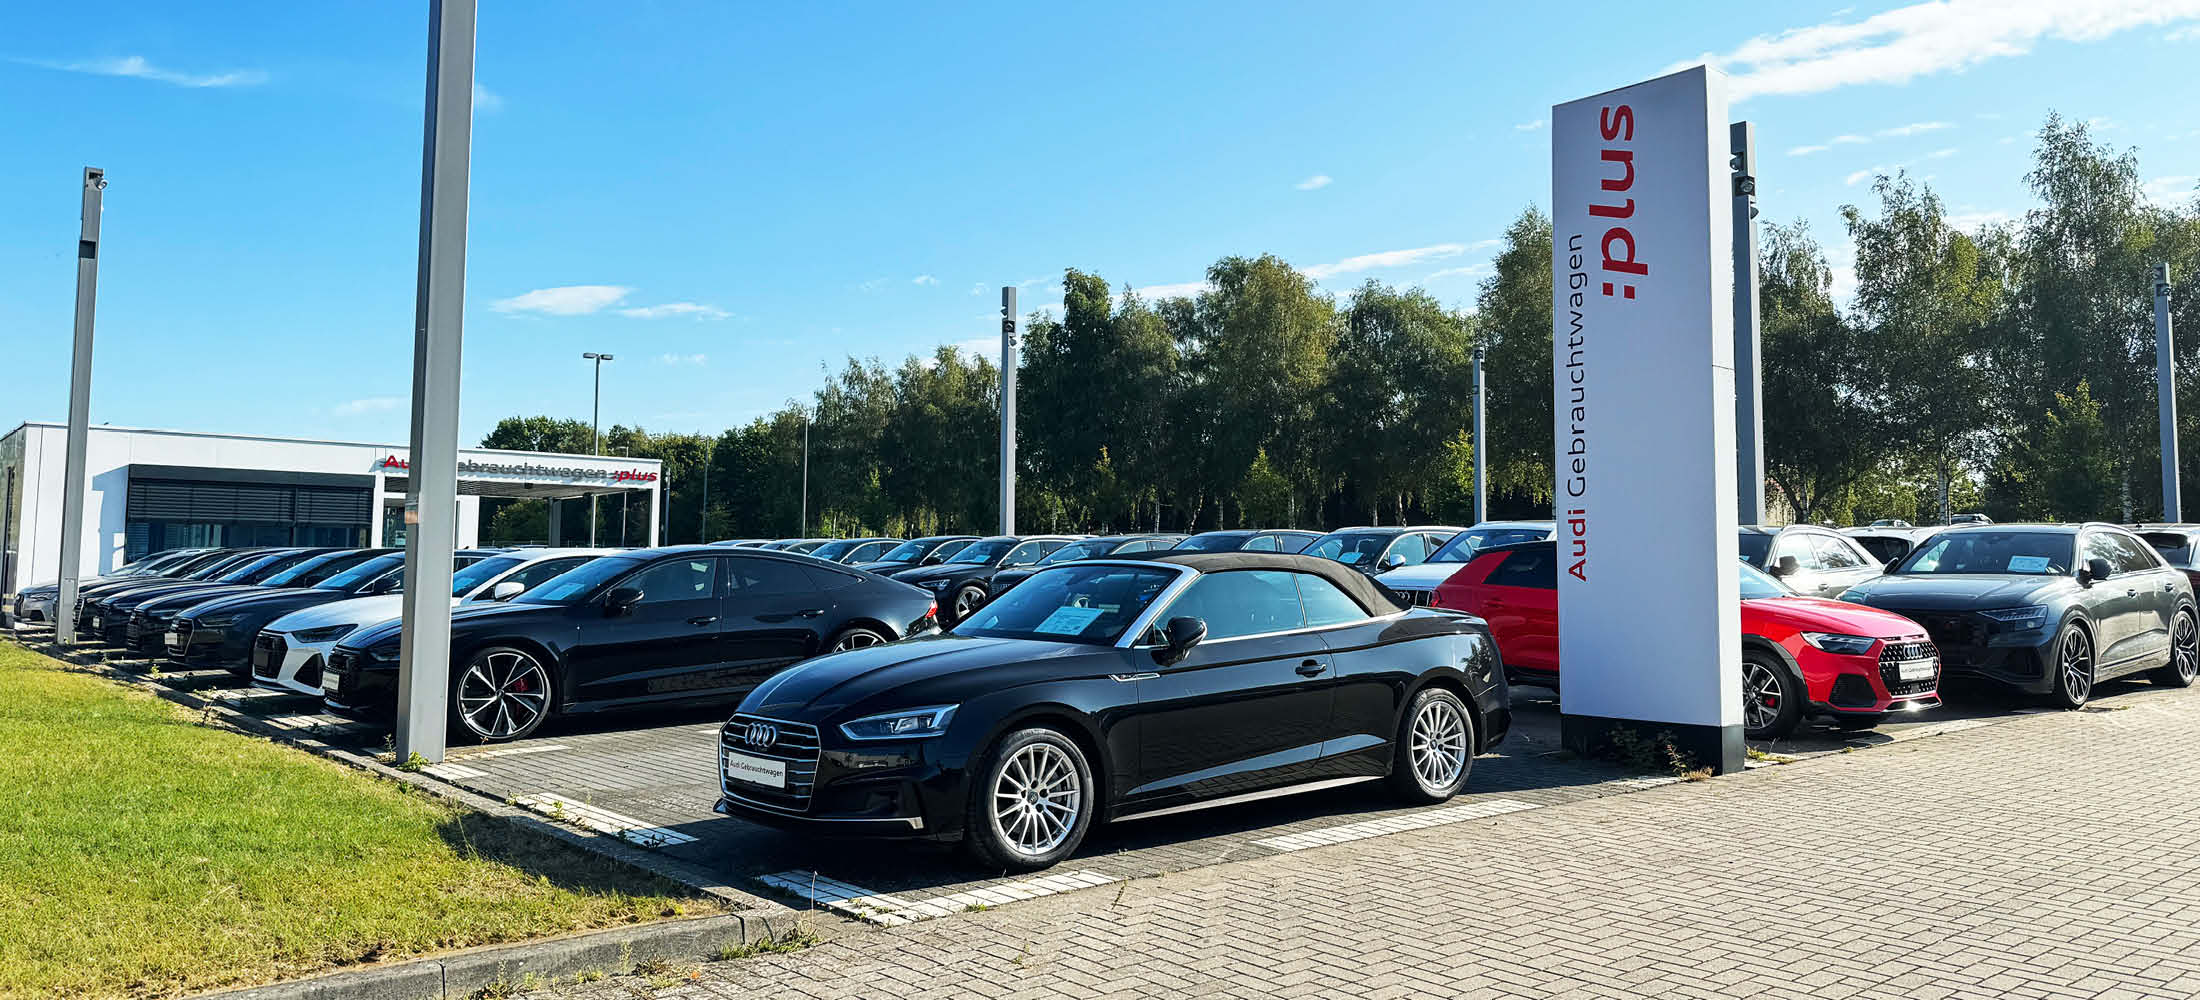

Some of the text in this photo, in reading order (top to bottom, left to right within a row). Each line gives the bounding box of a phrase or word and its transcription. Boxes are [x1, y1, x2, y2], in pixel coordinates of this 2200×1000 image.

[1589, 104, 1649, 300] :plus
[1566, 233, 1588, 582] Audi Gebrauchtwagen
[458, 459, 607, 480] ebrauchtwagen
[741, 762, 783, 777] Gebrauchtwagen
